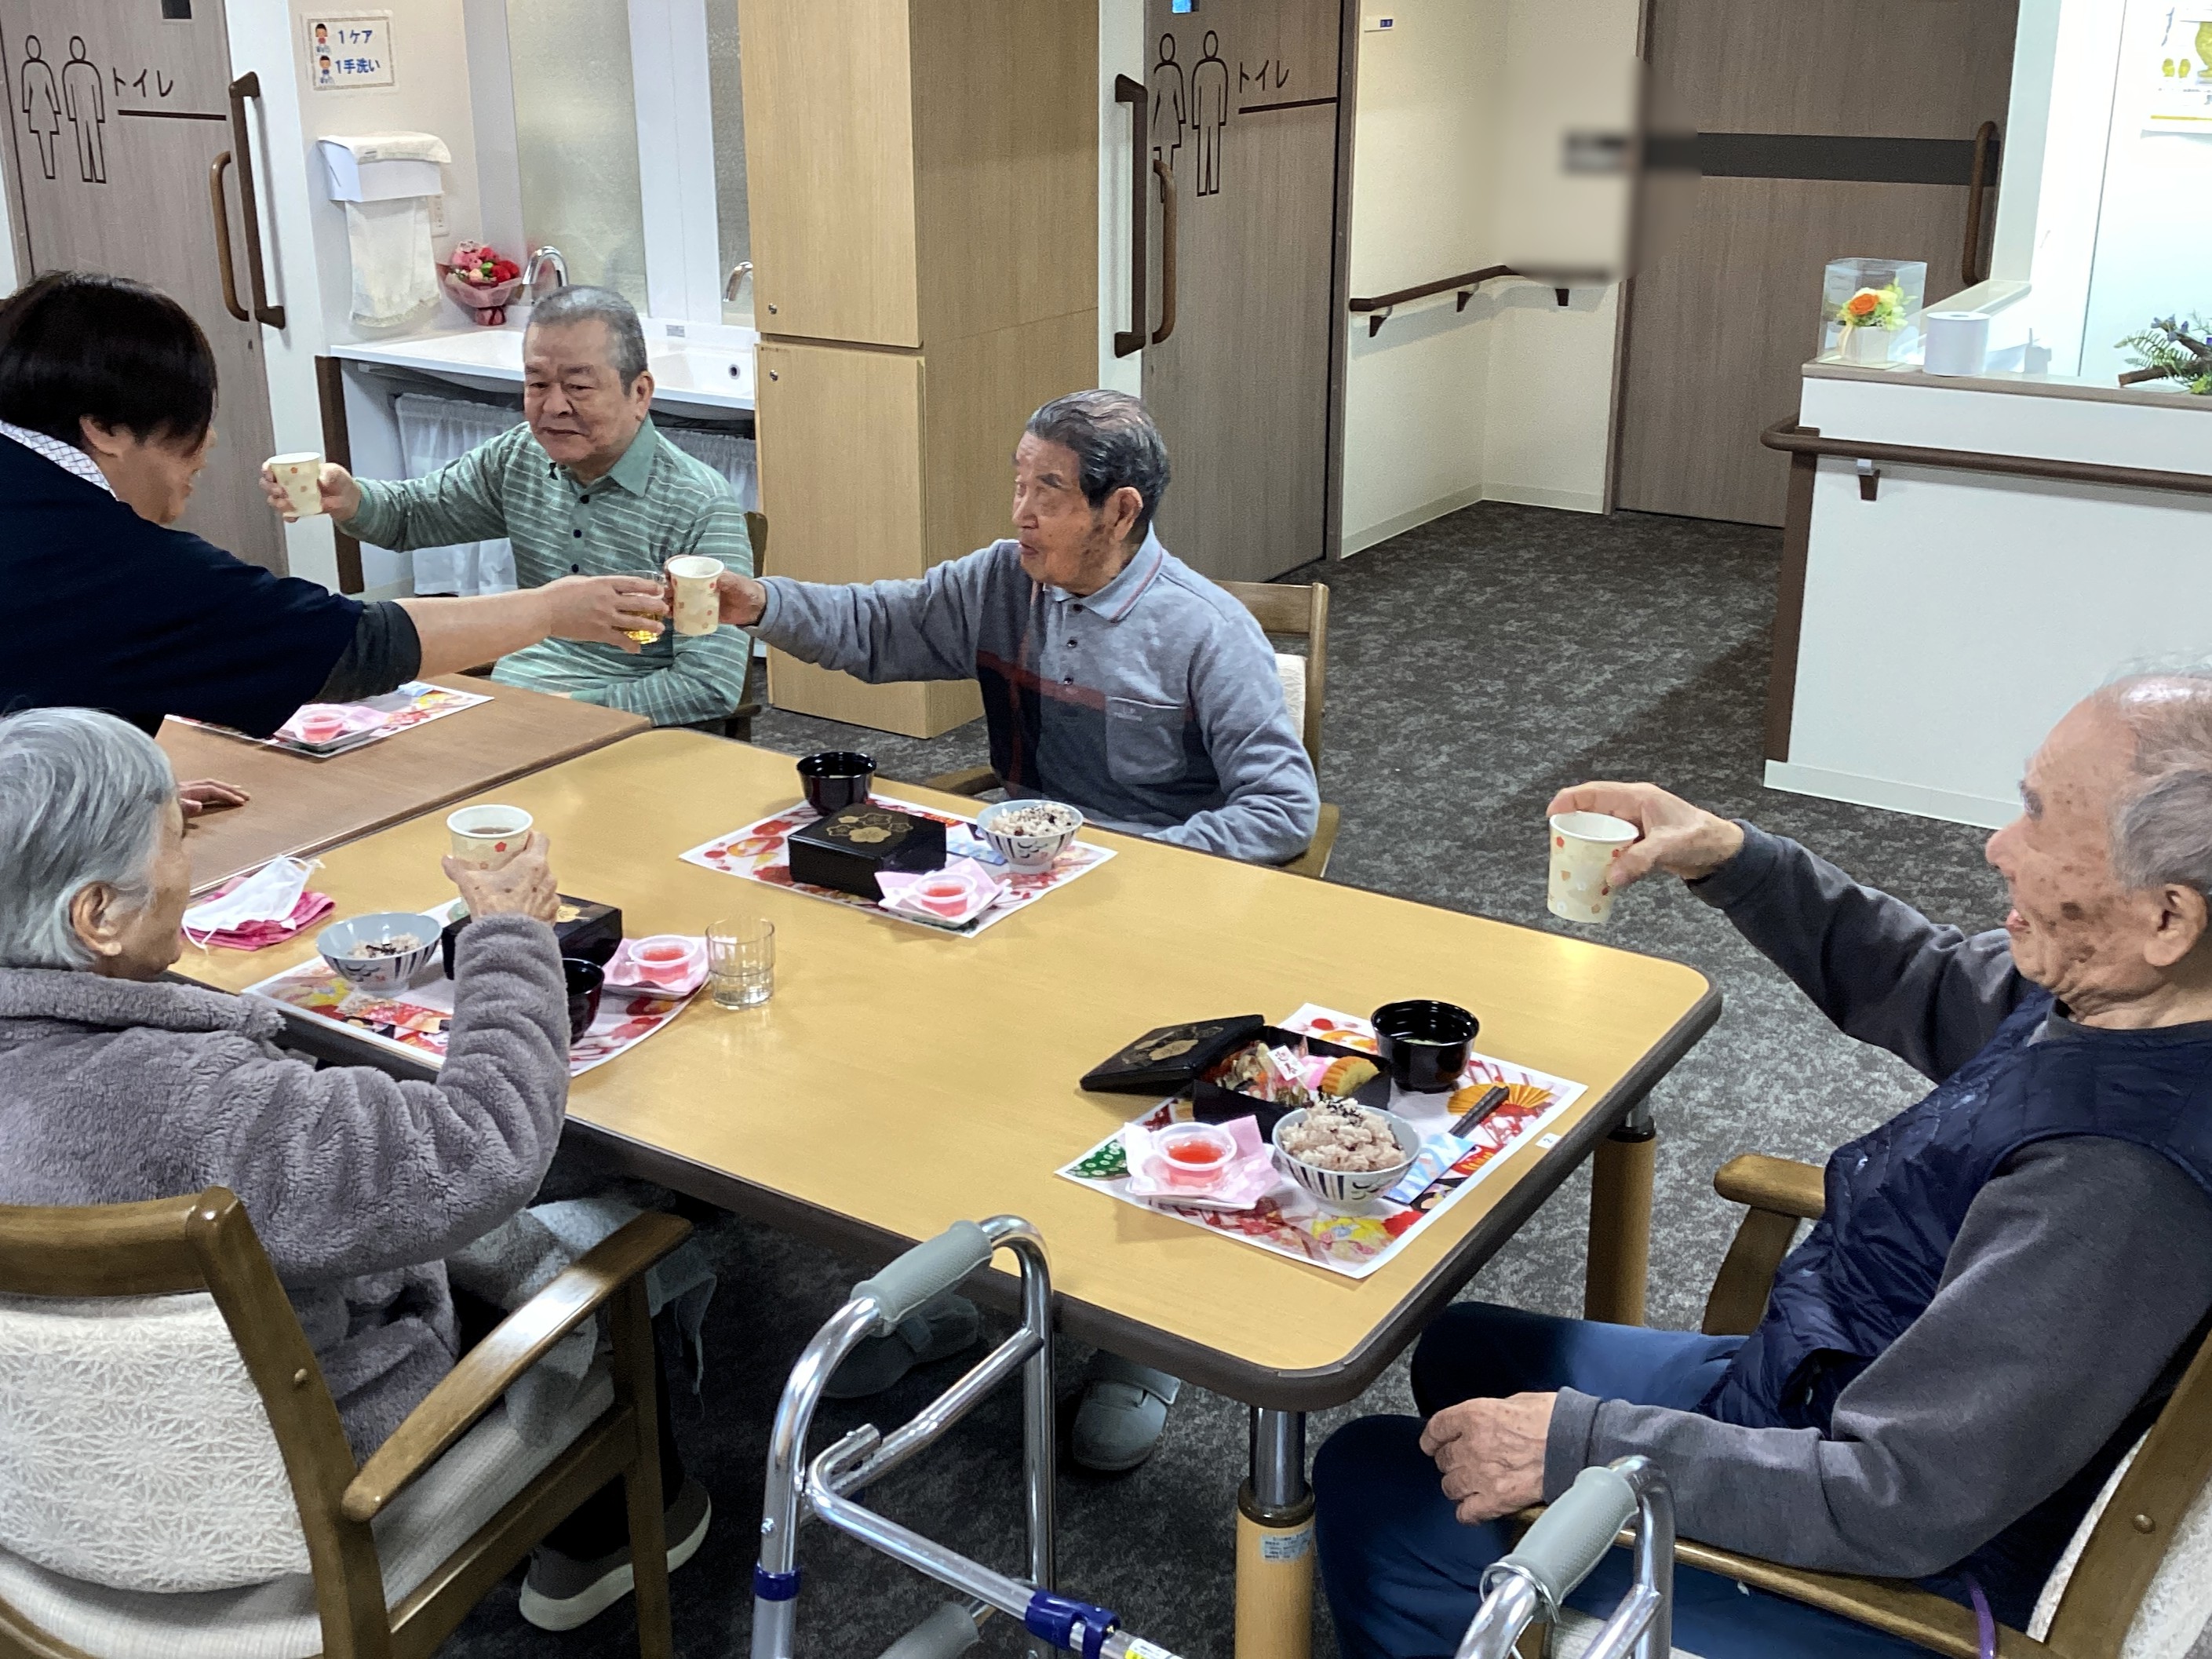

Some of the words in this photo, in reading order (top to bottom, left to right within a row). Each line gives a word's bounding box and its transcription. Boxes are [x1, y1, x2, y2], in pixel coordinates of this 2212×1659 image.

[112, 66, 173, 97] トイレ
[1239, 60, 1289, 93] トイレ
